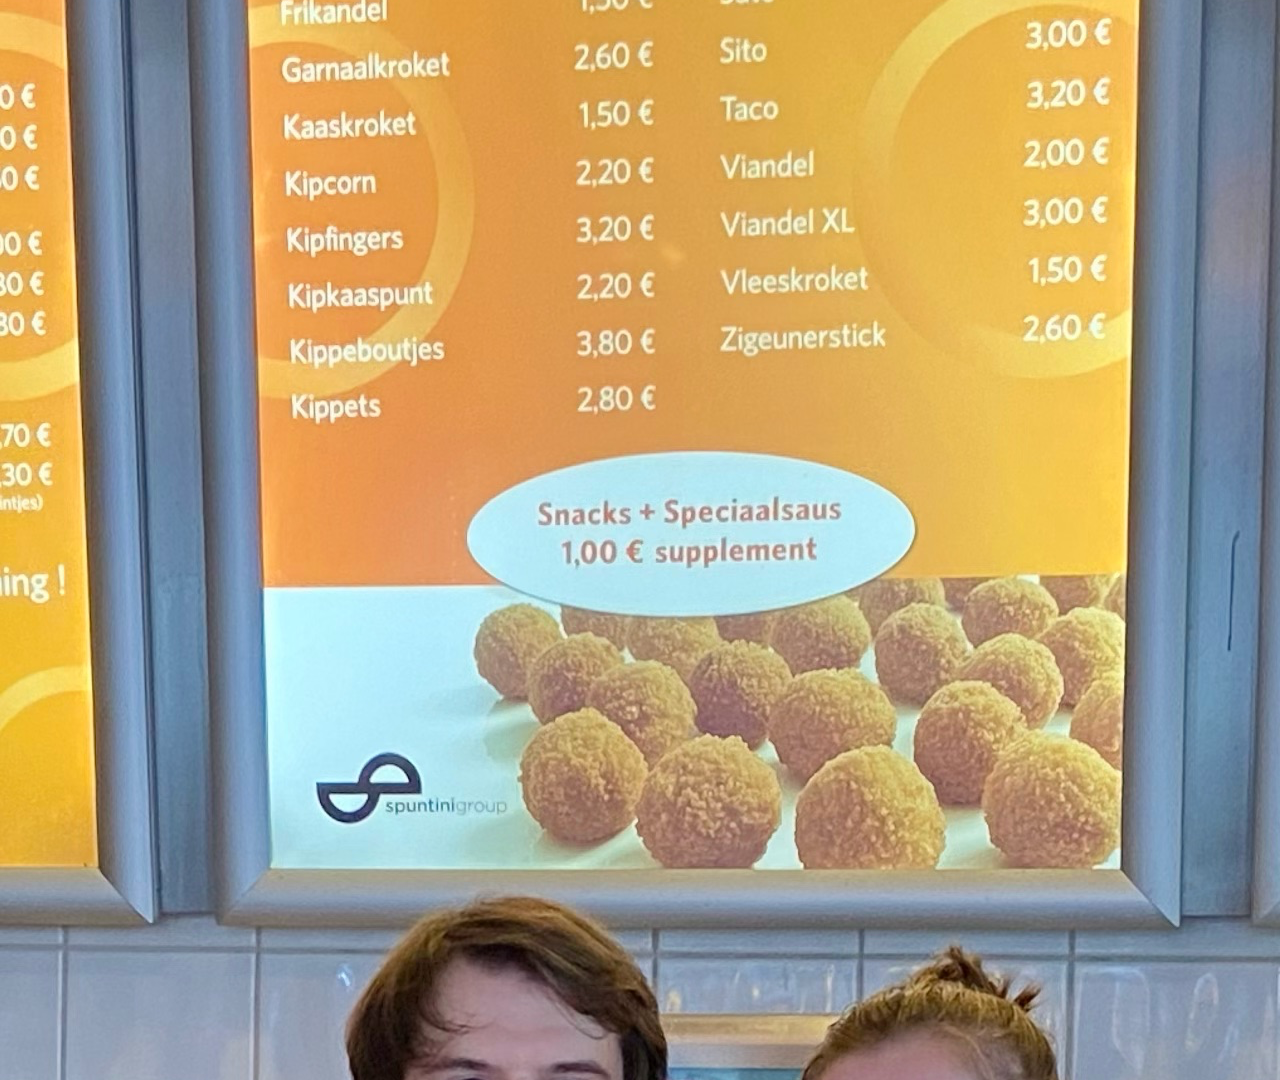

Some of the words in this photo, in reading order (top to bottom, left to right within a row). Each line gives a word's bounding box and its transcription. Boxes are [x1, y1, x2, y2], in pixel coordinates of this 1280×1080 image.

[281, 0, 387, 23] Frikandel
[720, 37, 766, 63] Sito
[1026, 20, 1086, 49] 3,00
[282, 52, 449, 82] Garnaalkroket
[575, 42, 629, 70] 2,60
[720, 96, 778, 120] Taco
[284, 110, 416, 139] Kaaskroket
[721, 151, 813, 178] Viandel
[286, 171, 376, 200] Kipcorn
[721, 209, 813, 236] Viandel
[823, 208, 854, 232] XL
[287, 226, 403, 257] Kipfingers
[721, 266, 867, 294] Vleeskroket
[289, 282, 432, 312] Kipkaaspunt
[291, 338, 444, 368] Kippeboutjes
[721, 322, 885, 356] Zigeunerstick
[292, 395, 380, 423] Kippets
[538, 500, 632, 526] Snacks
[664, 496, 842, 529] Speciaalsaus
[561, 539, 618, 569] 1,00
[655, 536, 818, 569] supplement
[385, 797, 508, 816] spuntinigroup
